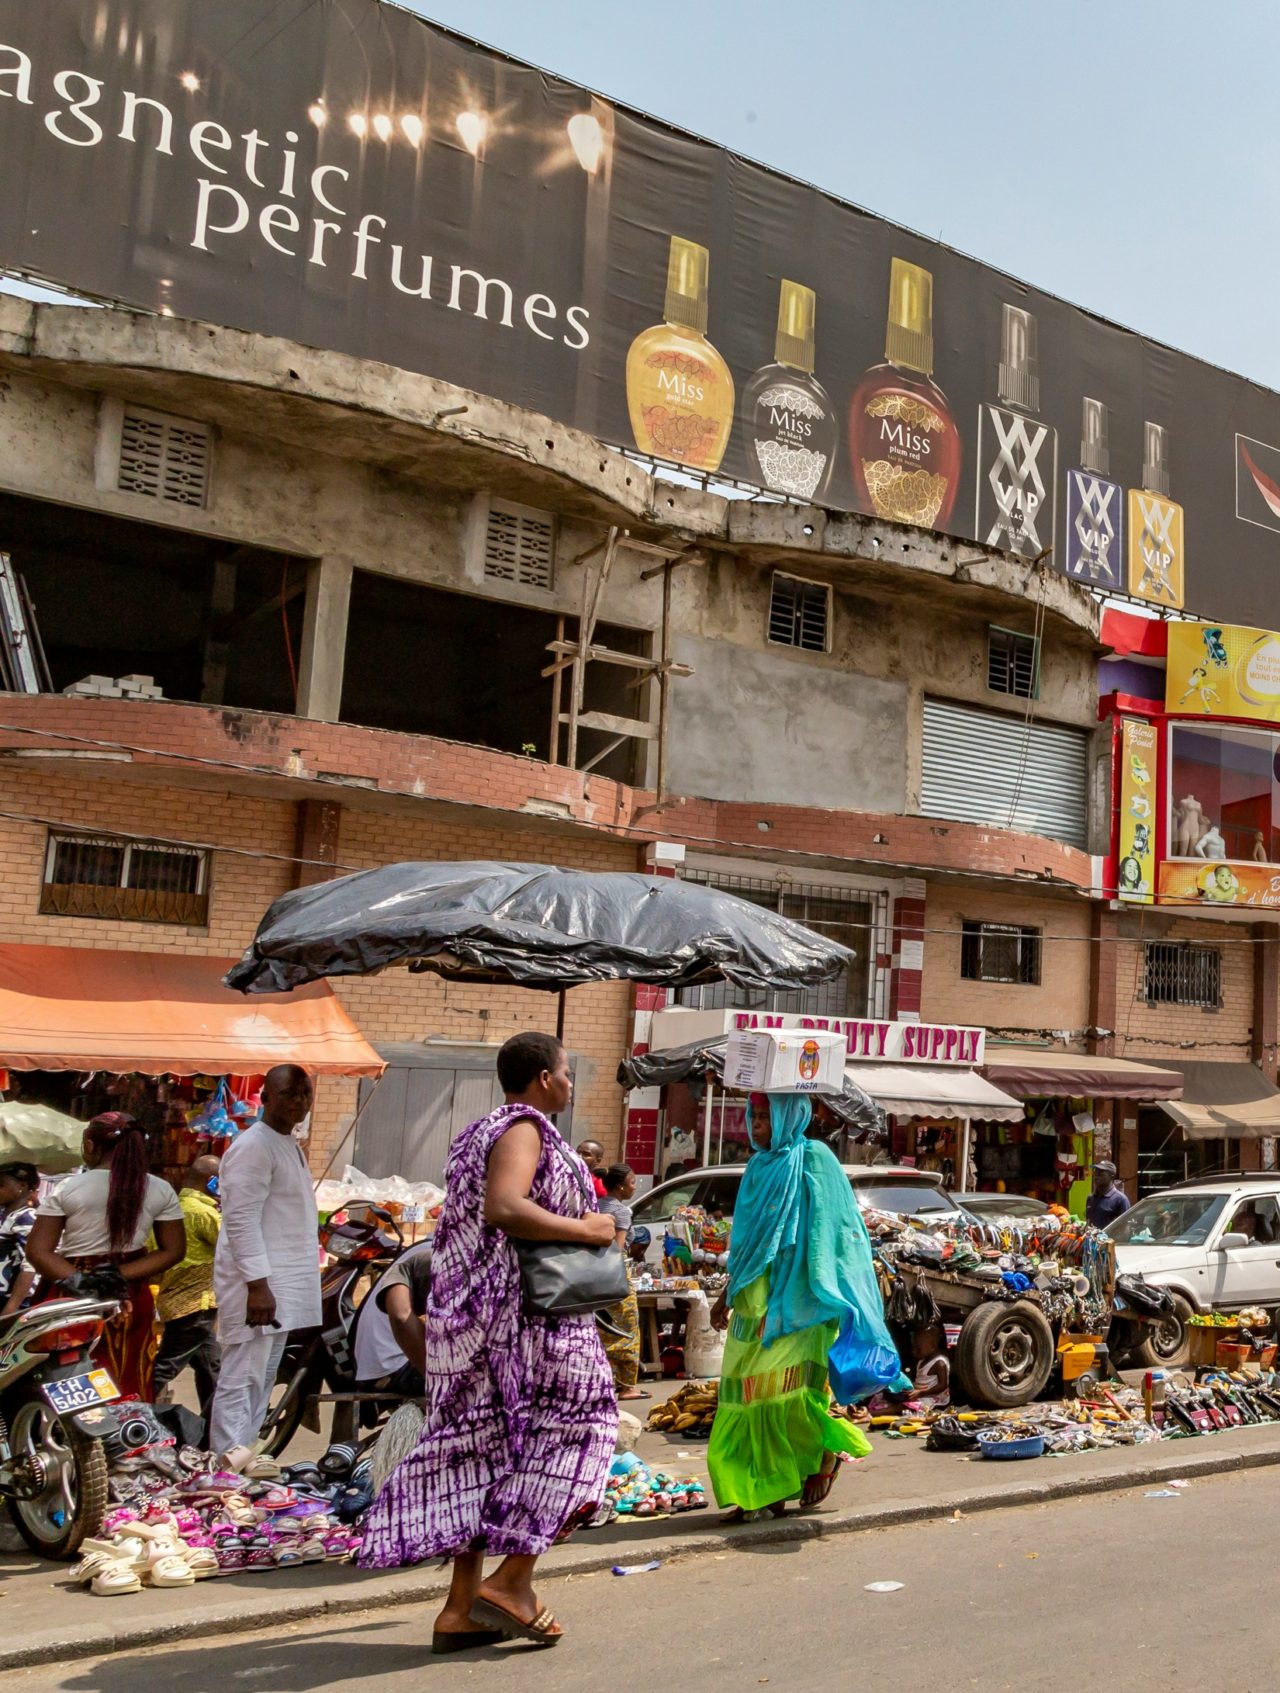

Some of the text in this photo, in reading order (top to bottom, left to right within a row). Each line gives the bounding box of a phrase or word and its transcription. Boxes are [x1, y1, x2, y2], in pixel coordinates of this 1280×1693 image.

[190, 177, 591, 349] perfumes
[657, 369, 704, 401] Miss
[770, 407, 812, 436] Miss
[880, 418, 931, 454] Miss
[889, 445, 921, 461] plum red
[996, 481, 1039, 513] VIP
[1080, 526, 1110, 549] VIP
[1143, 546, 1171, 569] VIP
[902, 1026, 982, 1062] SUPPLY
[795, 1082, 818, 1091] PASTA
[54, 1387, 100, 1410] 5402
